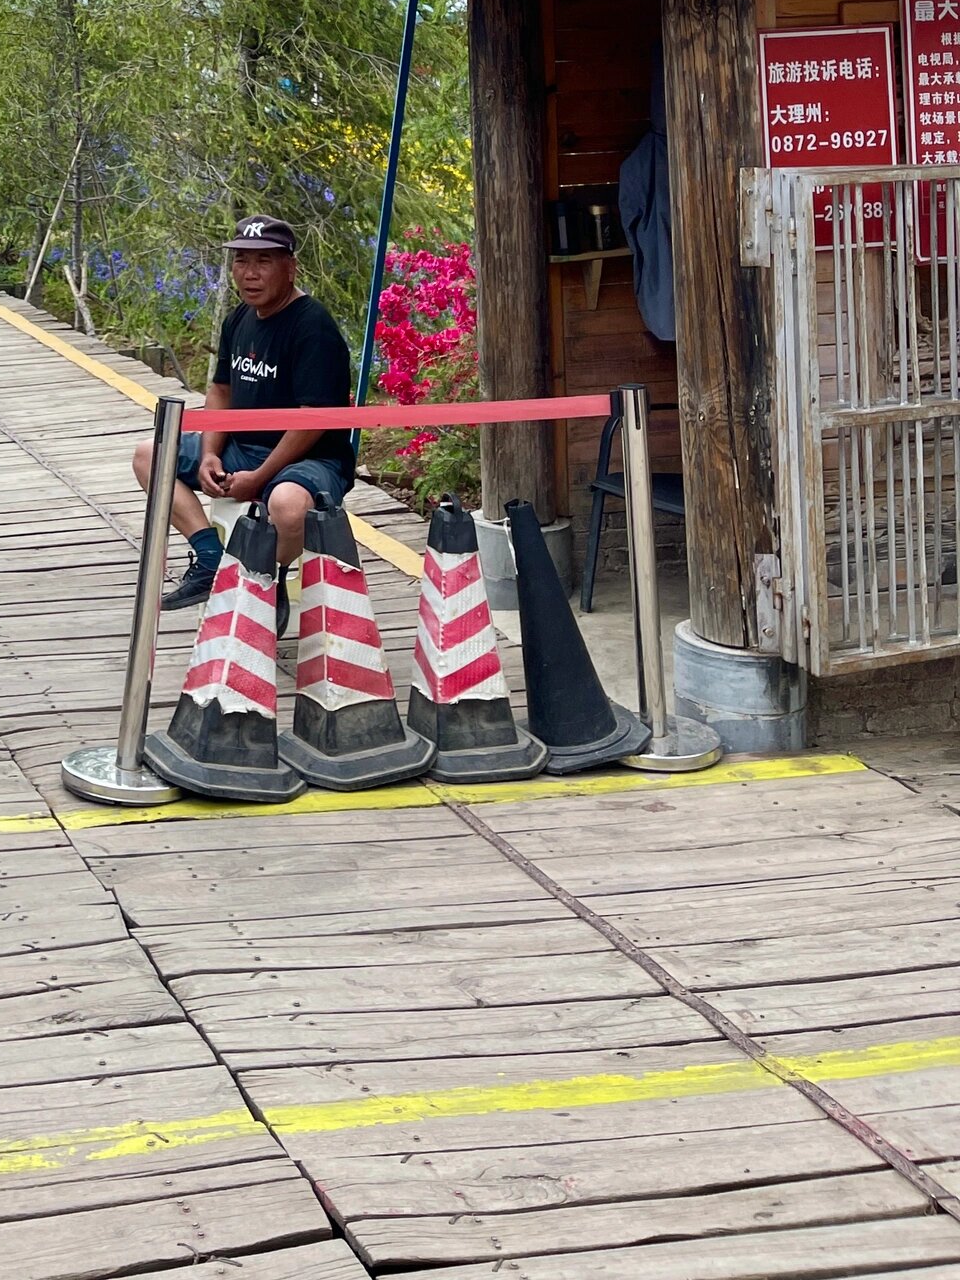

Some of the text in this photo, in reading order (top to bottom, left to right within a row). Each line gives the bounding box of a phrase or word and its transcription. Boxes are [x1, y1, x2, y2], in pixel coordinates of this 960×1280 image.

[768, 57, 880, 83] 旅游投诉电话：
[770, 102, 830, 126] 大理州：
[920, 111, 960, 126] 牧场景
[771, 129, 888, 153] 0872-96927
[921, 131, 960, 145] 规定，
[922, 150, 960, 165] 大承载
